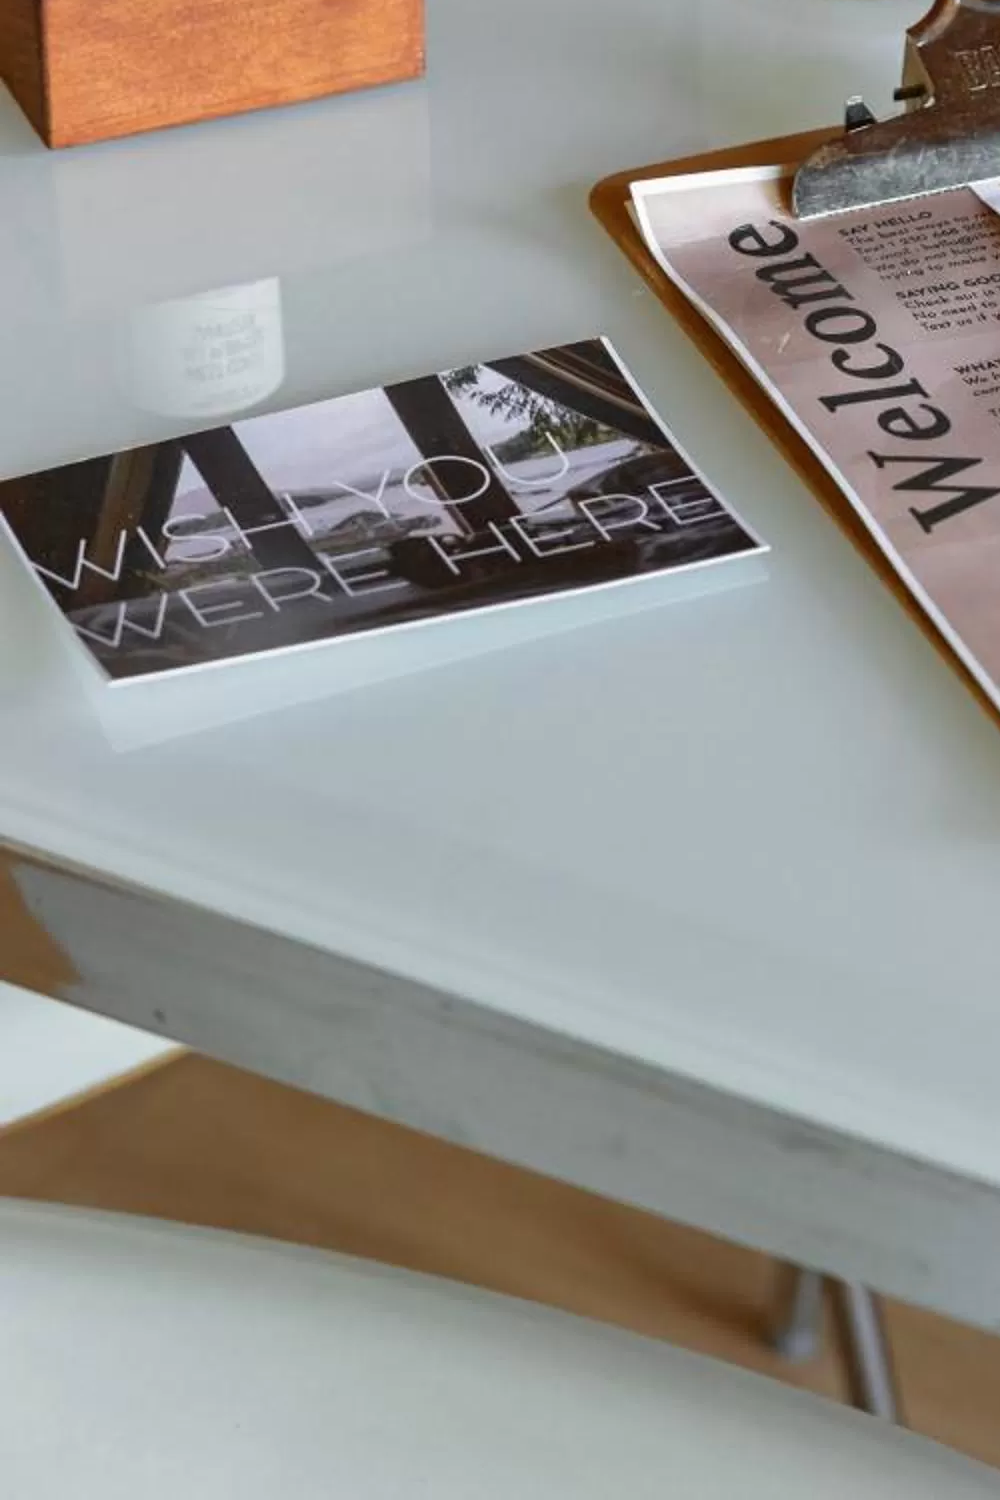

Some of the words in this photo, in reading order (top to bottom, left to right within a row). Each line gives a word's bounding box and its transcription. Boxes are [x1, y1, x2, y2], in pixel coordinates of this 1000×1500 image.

[837, 224, 869, 237] SAY
[872, 210, 933, 229] HELLO
[895, 281, 961, 300] SAYING
[30, 491, 314, 592] WISH
[335, 431, 570, 521] YOU
[72, 546, 410, 649] WERE
[427, 473, 726, 576] HERE
